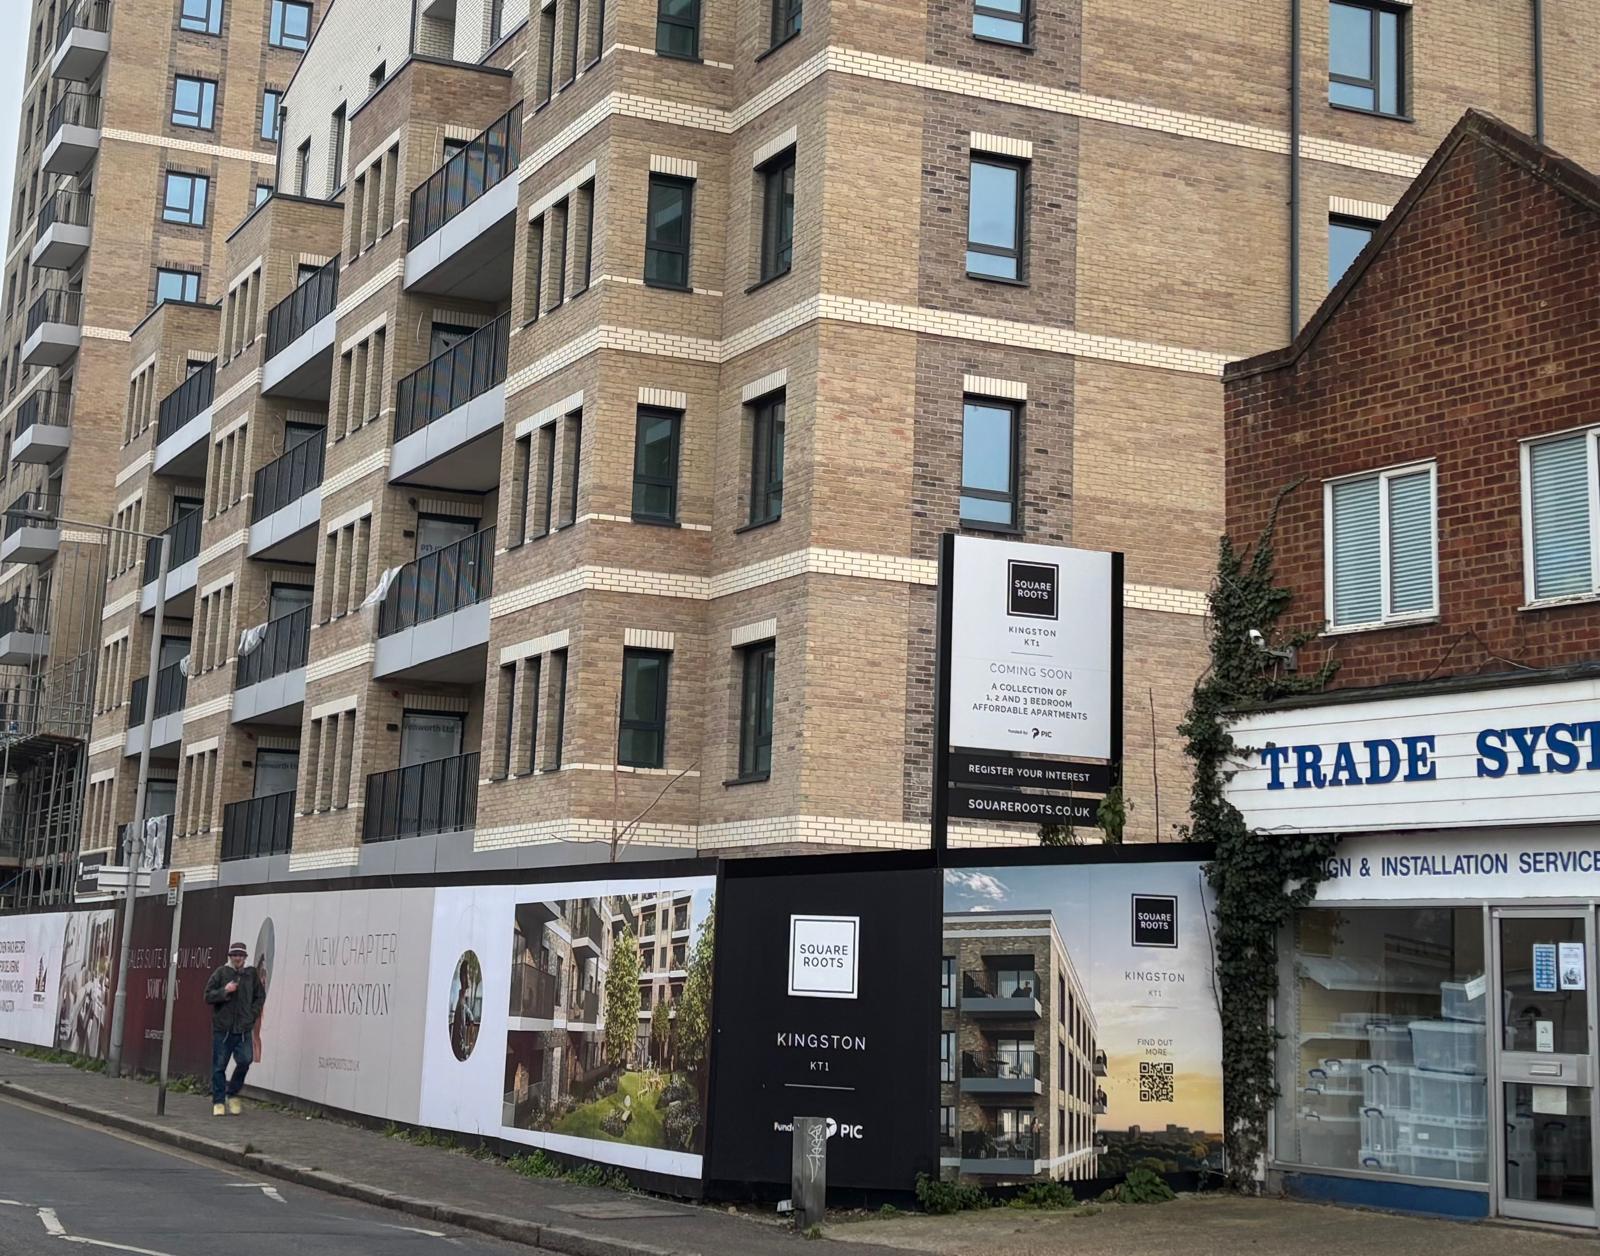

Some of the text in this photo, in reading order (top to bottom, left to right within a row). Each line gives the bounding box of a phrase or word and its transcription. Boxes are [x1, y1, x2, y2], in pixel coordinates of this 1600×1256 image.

[1014, 579, 1052, 591] SQUARE
[1017, 589, 1049, 600] ROOTS
[1008, 626, 1057, 637] KINGSTON
[1024, 639, 1040, 647] KT1
[989, 662, 1073, 680] COMING SOON
[999, 683, 1054, 696] COLLECTION
[1056, 688, 1068, 696] OF
[994, 694, 1000, 702] 2
[1002, 695, 1021, 704] AND
[1023, 697, 1028, 706] 3
[1030, 697, 1073, 708] BEDROOM
[972, 703, 1088, 721] AFFORDABLE APARTMENTS
[1040, 730, 1053, 739] PIC
[1261, 734, 1437, 790] TRADE
[968, 763, 1090, 782] REGISTER YOUR INTEREST
[968, 799, 1090, 817] SQUAREROOTS.CO.UK
[1359, 857, 1371, 877] &
[1381, 852, 1508, 877] INSTALLATION
[1137, 912, 1172, 922] SQUARE
[1140, 921, 1169, 930] ROOTS
[303, 932, 398, 966] A NEW CHAPTER
[799, 944, 849, 955] SQUARE
[190, 946, 213, 968] HOME
[803, 957, 844, 968] ROOTS
[1124, 971, 1185, 983] KINGSTON
[161, 978, 181, 1001] ON
[302, 982, 391, 1015] FOR KINGSTON
[776, 1032, 867, 1051] KINGSTON
[1137, 1038, 1174, 1047] FIND OUT
[1145, 1048, 1168, 1056] MORE
[810, 1061, 830, 1072] KT1
[840, 1123, 863, 1139] PIC
